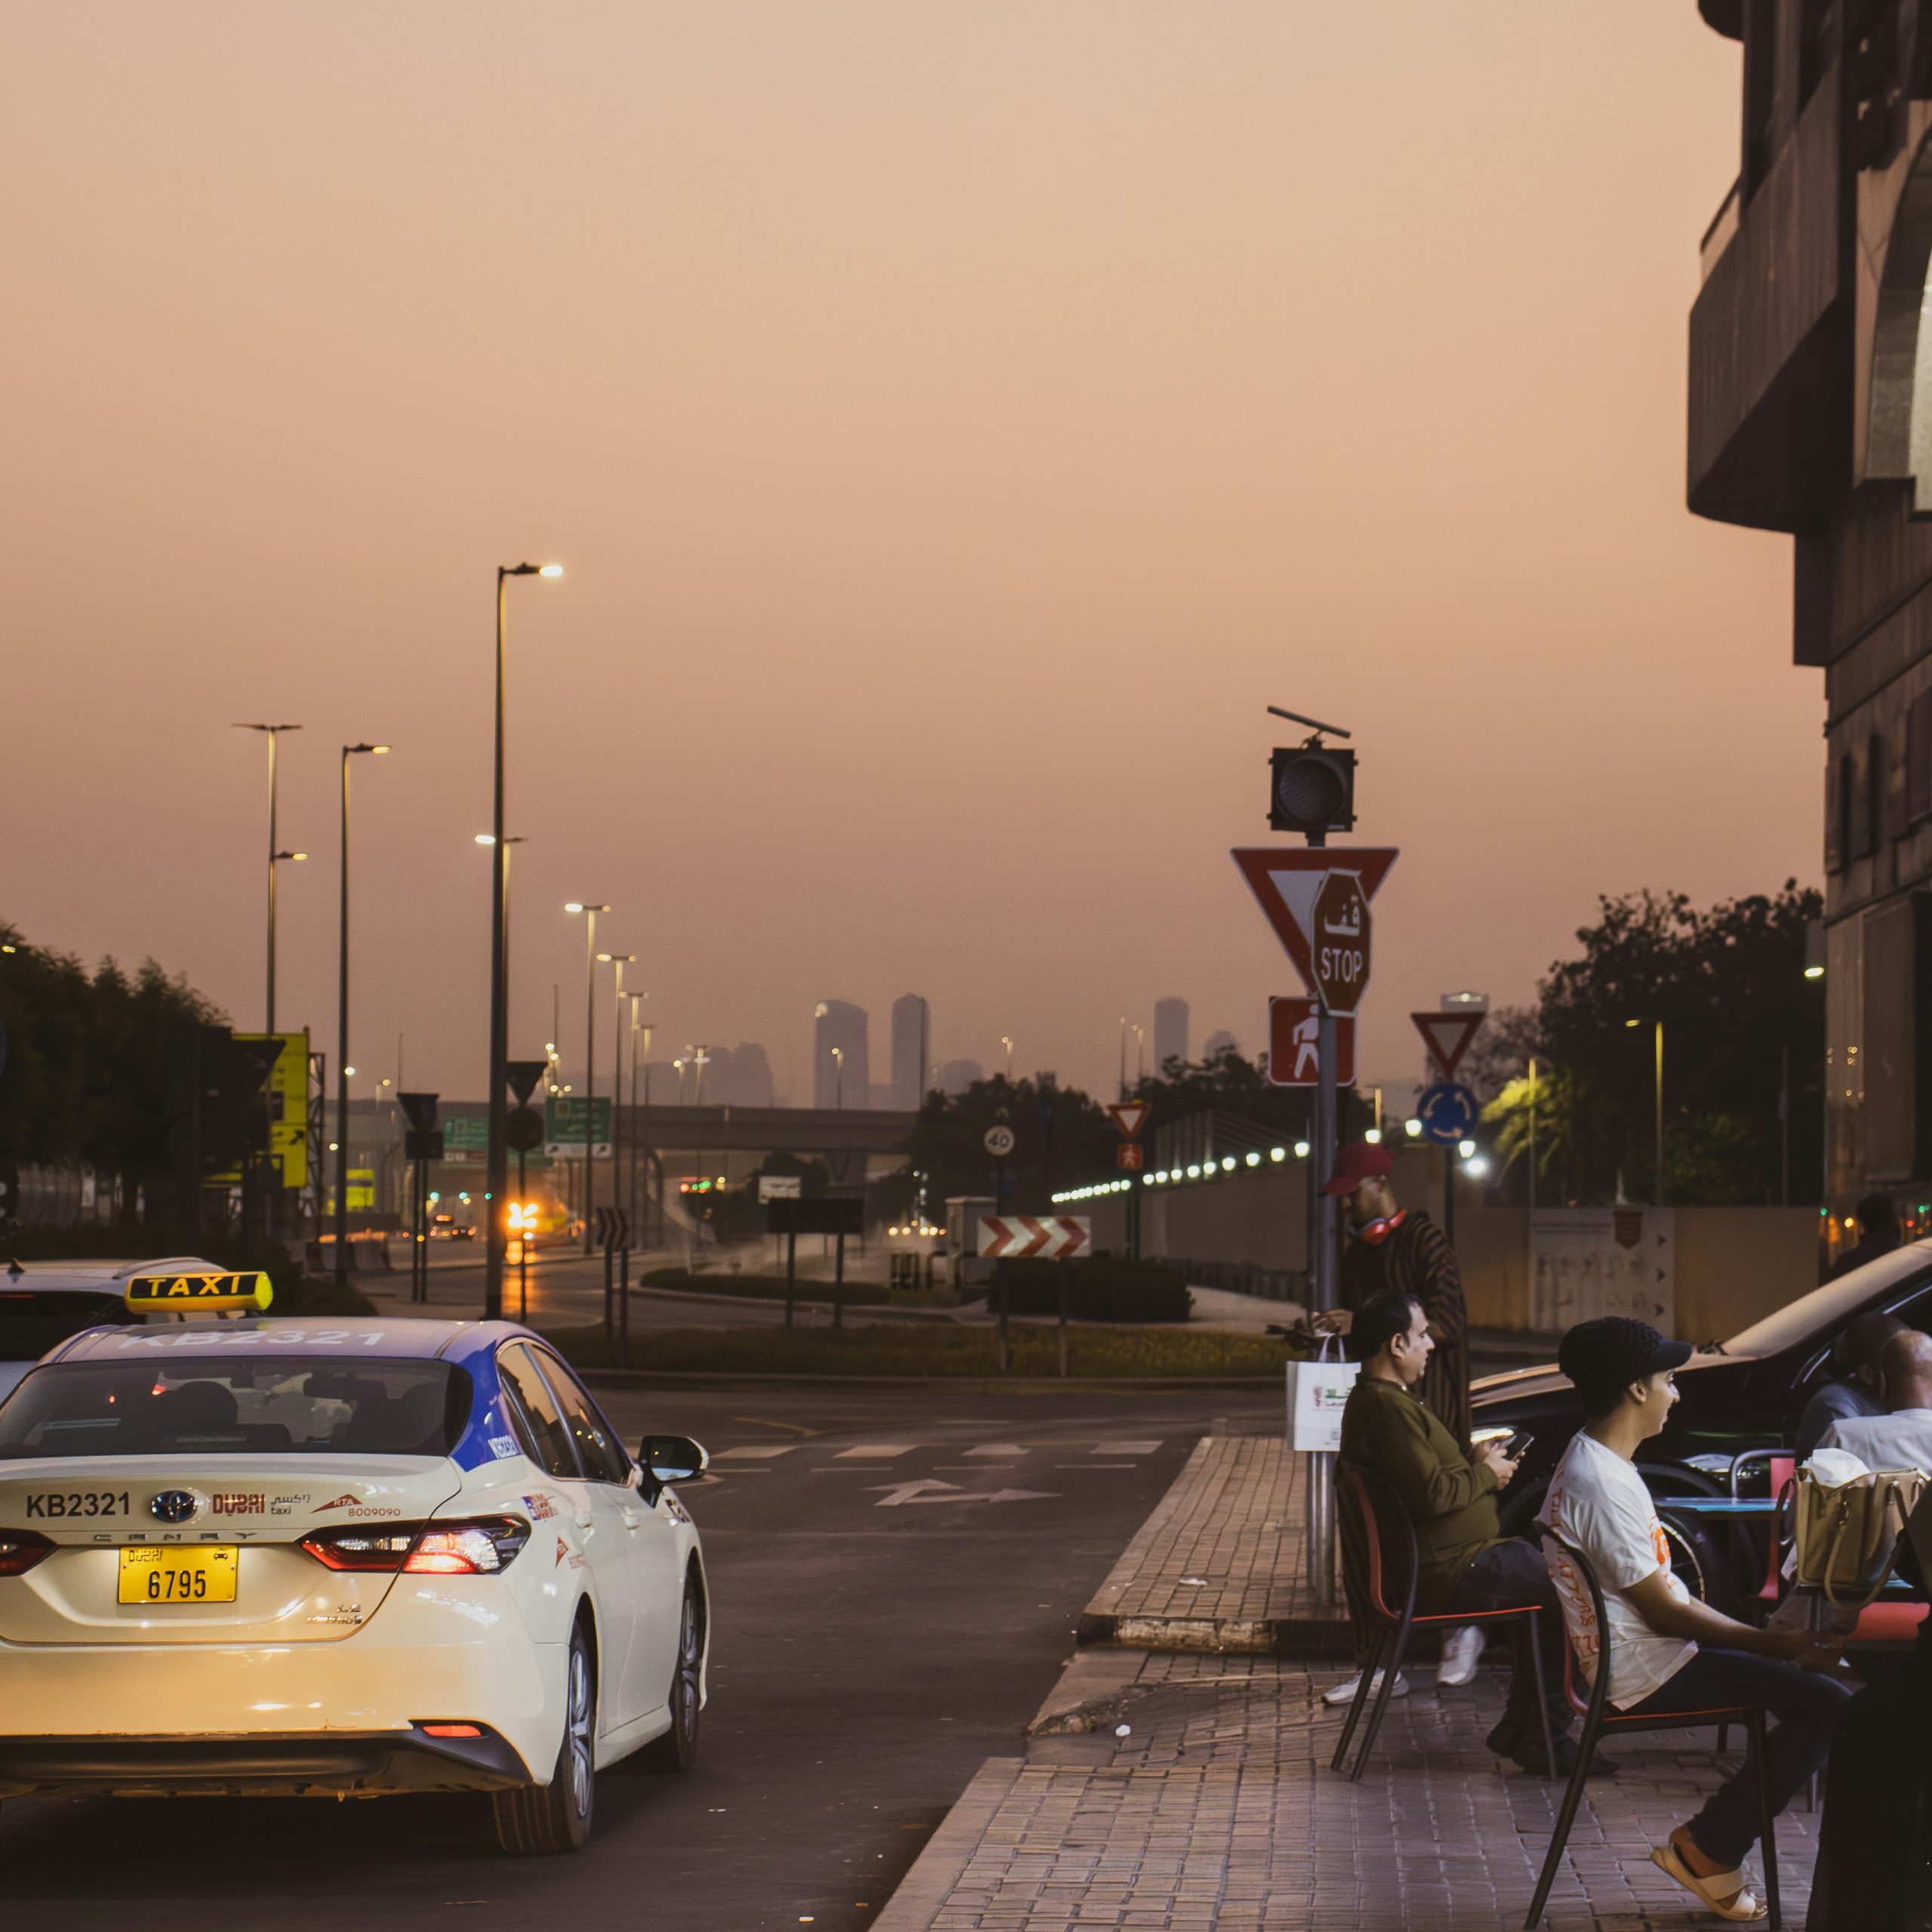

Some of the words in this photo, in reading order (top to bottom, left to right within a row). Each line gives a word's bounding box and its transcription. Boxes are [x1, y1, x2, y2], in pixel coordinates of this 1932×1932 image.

[1321, 947, 1362, 983] STOP
[989, 1134, 1010, 1148] 40
[147, 1275, 240, 1297] TAXI
[118, 1331, 385, 1349] KB2321
[26, 1491, 130, 1518] KB2321
[271, 1506, 291, 1515] taxi
[334, 1498, 354, 1506] RTA
[348, 1508, 401, 1516] 8009090
[148, 1570, 206, 1598] 6795
